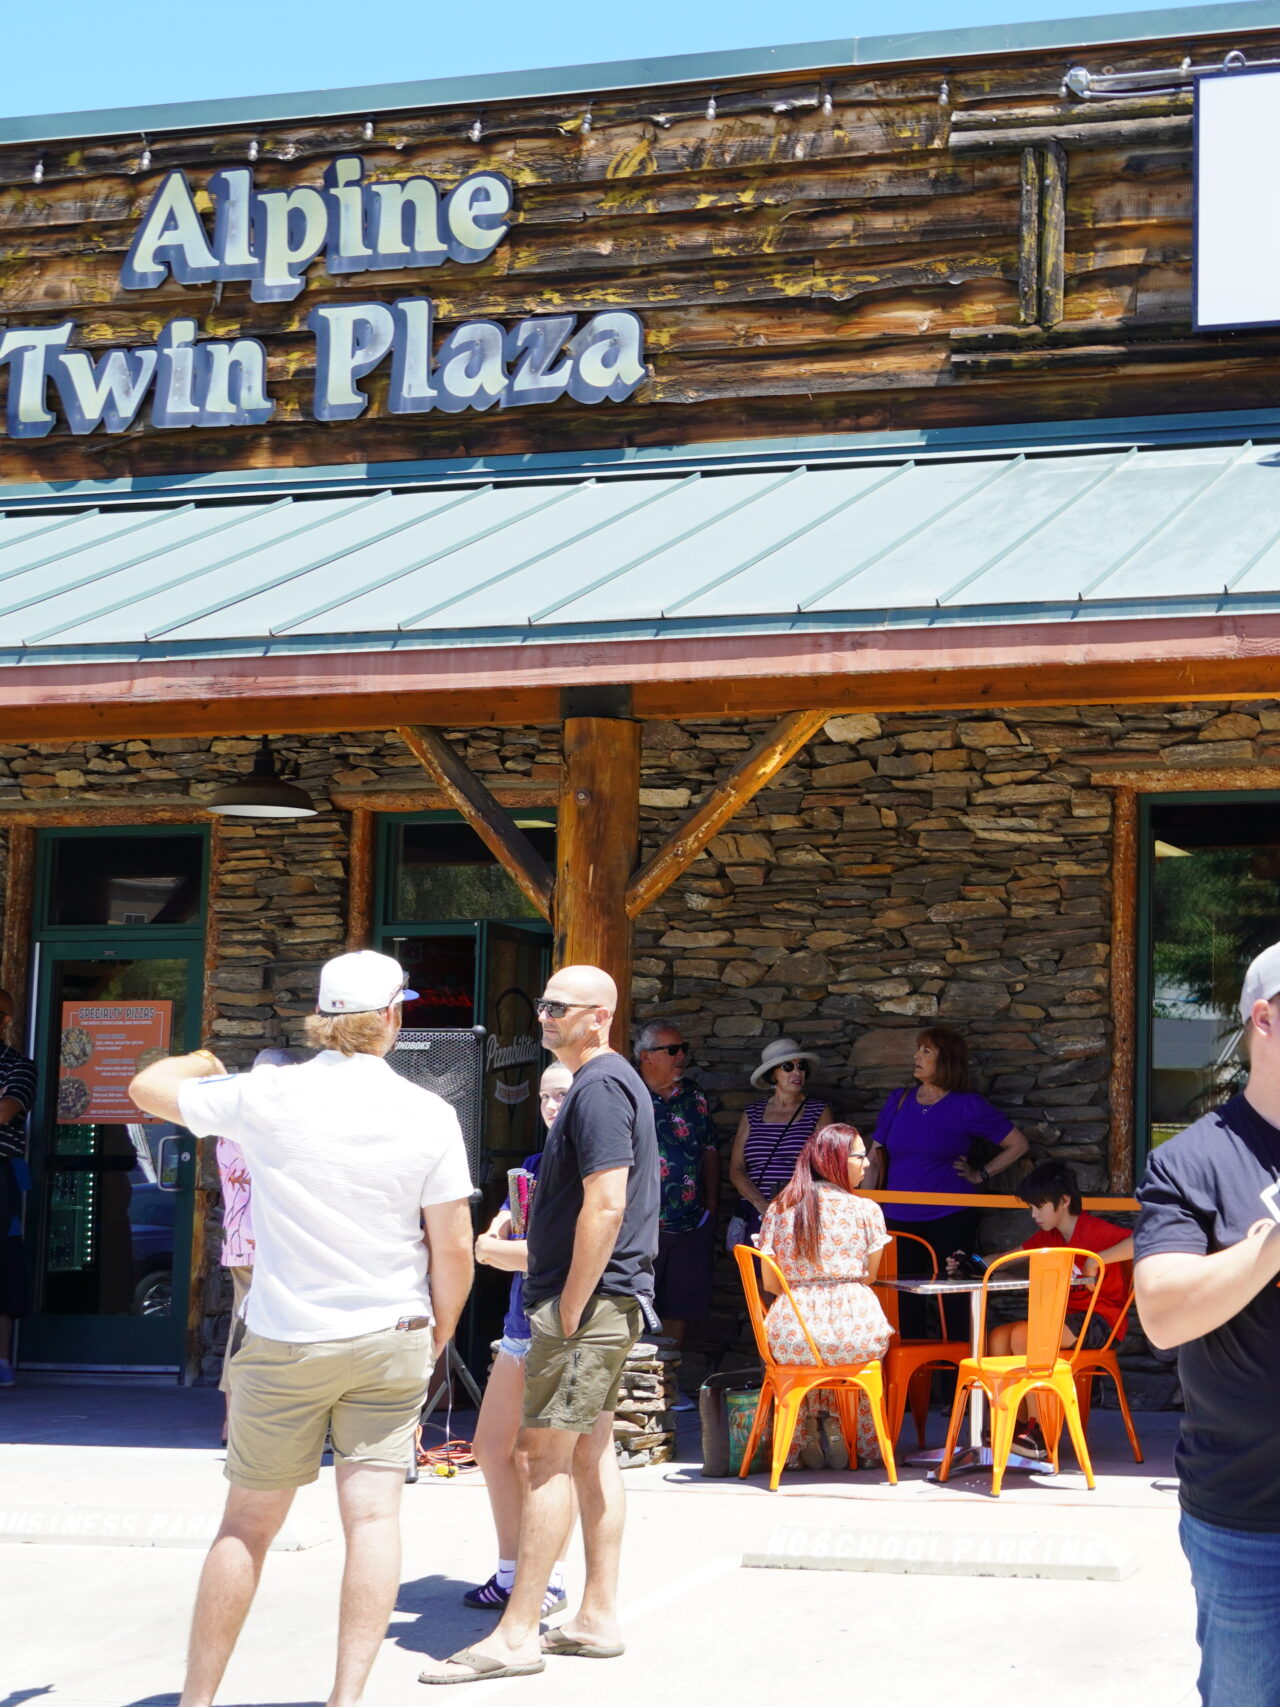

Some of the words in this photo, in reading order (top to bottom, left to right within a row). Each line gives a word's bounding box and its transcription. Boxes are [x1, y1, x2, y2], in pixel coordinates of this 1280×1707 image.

[121, 154, 513, 302] Alpine
[0, 318, 275, 438] Twin
[309, 296, 649, 421] Plaza
[79, 1007, 122, 1019] SPECIALTY
[126, 1007, 155, 1019] PIZZAS
[953, 1537, 1104, 1565] PARKING
